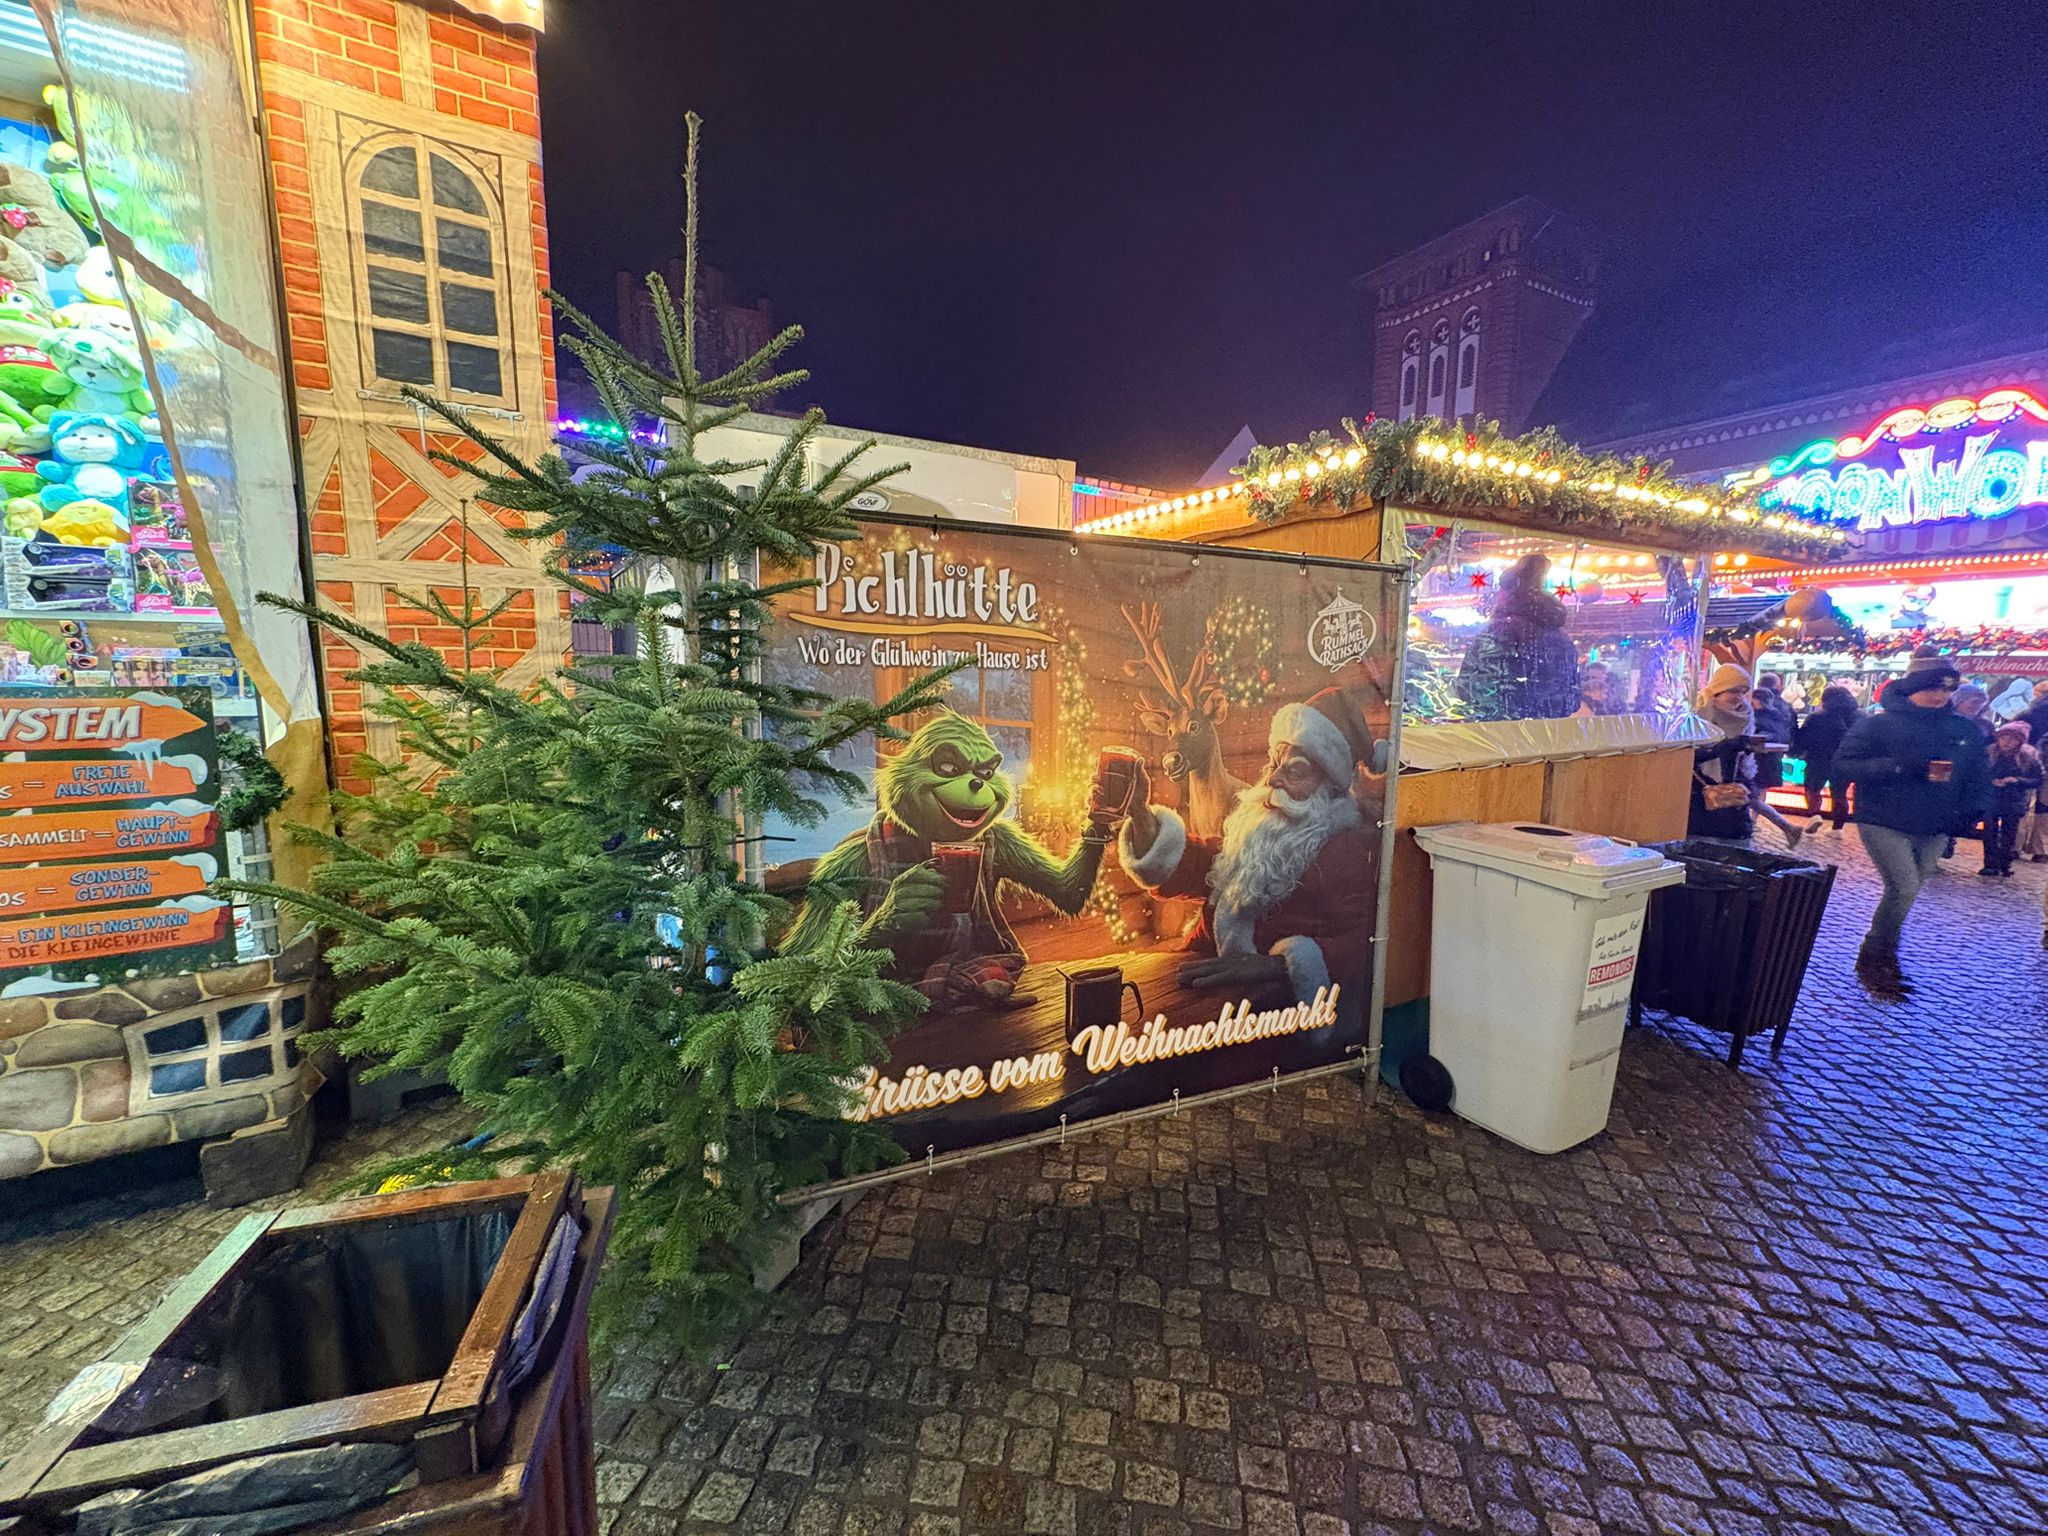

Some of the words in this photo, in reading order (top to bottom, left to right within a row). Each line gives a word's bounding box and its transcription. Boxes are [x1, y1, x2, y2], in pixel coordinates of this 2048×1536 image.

[812, 540, 1039, 623] Pichlhütte
[1321, 627, 1366, 651] RUMMEL
[798, 635, 830, 665] Wo
[835, 638, 866, 666] der
[871, 637, 947, 668] Glühwein
[975, 641, 1021, 669] Hause
[1025, 647, 1049, 670] ist
[1320, 637, 1369, 667] RATHSACK
[72, 764, 132, 781] FREIE
[55, 780, 151, 798] AUSWAHL
[116, 815, 192, 833] HAUPT-
[116, 829, 191, 848] GEWINN
[70, 865, 161, 887] SONDER-
[75, 881, 153, 902] GEWINN
[18, 927, 56, 944] EIN
[61, 911, 190, 939] KLEINGEWINN
[8, 945, 40, 960] DIE
[47, 928, 181, 957] KLEINGEWINNE
[1589, 958, 1634, 984] REMONDIS
[990, 1050, 1066, 1092] vom
[1072, 983, 1342, 1073] Weihnachtsmarkt
